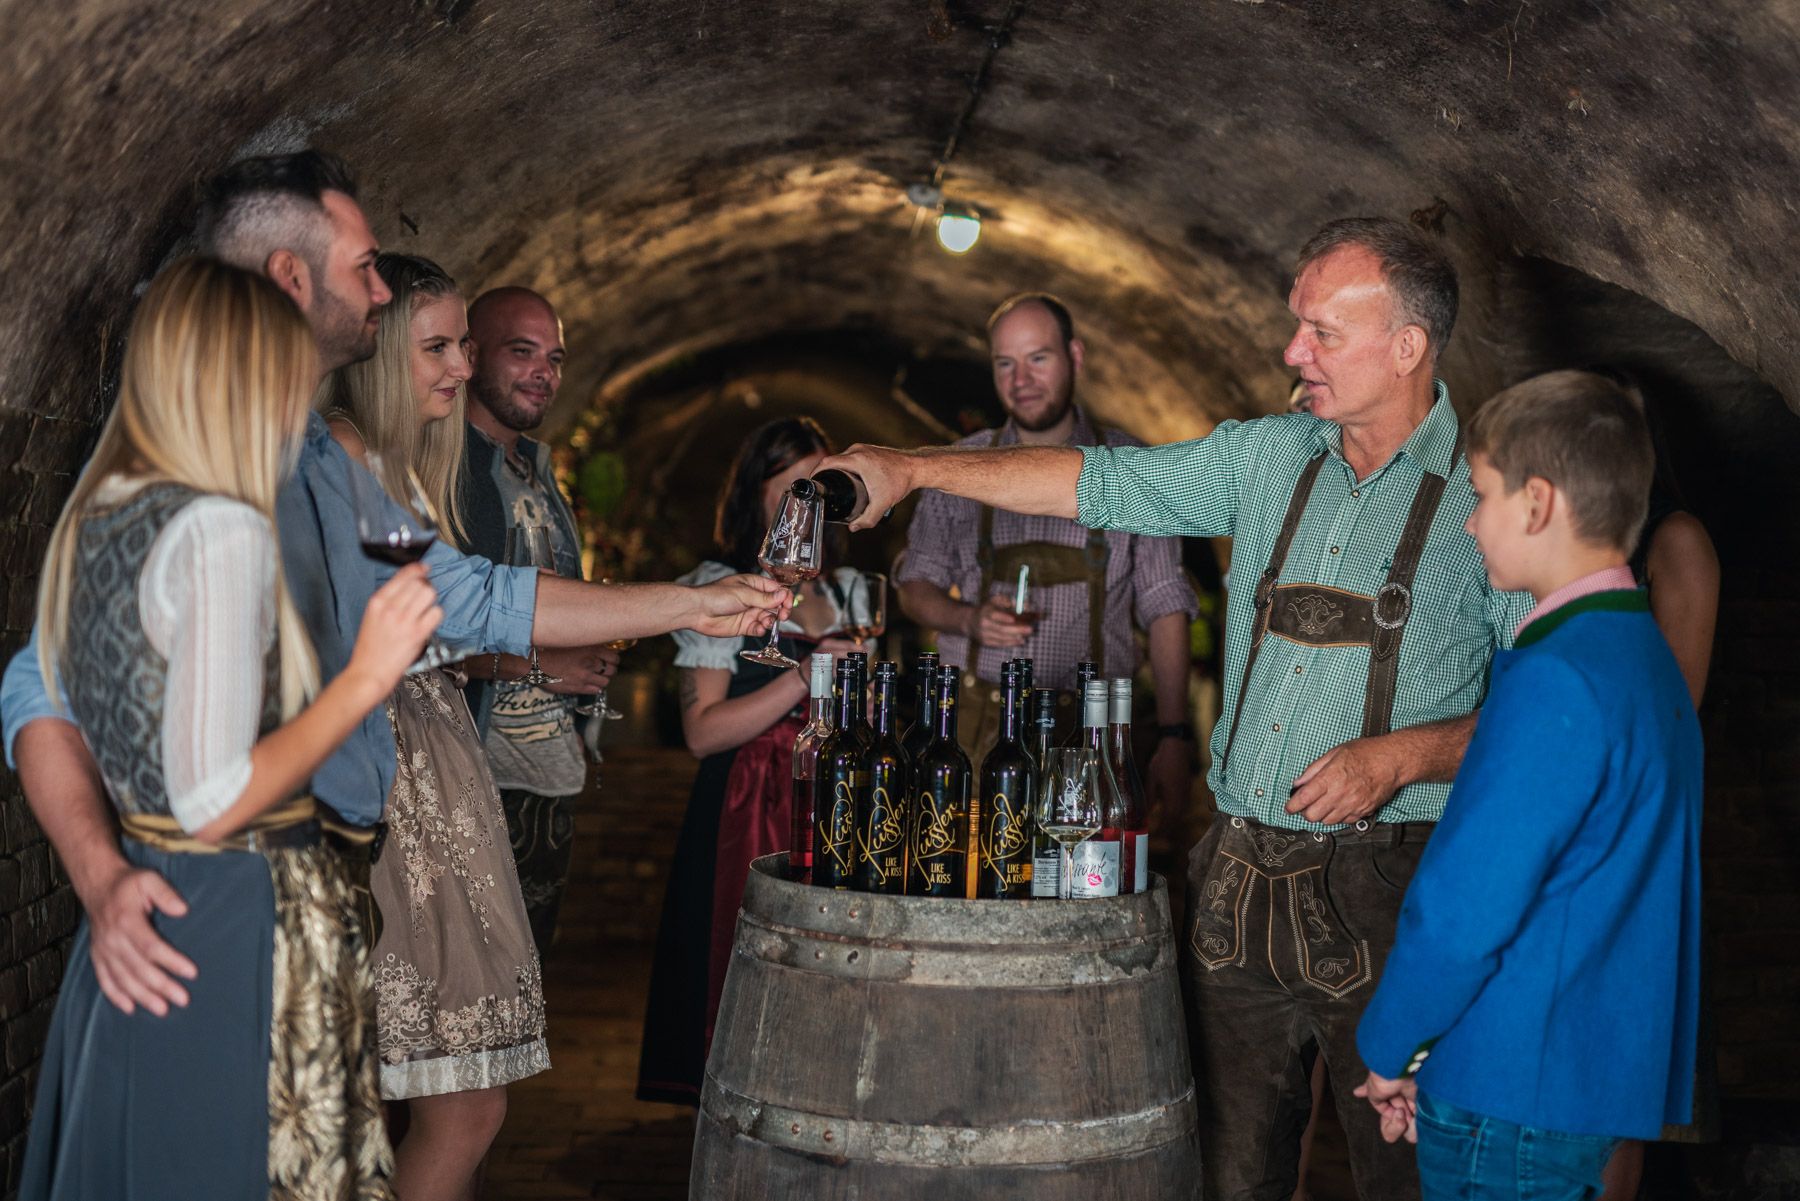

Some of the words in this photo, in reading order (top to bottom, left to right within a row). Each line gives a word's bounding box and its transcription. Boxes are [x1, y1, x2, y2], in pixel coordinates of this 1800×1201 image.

[885, 857, 898, 867] LIKE
[884, 867, 890, 877] A
[890, 867, 902, 877] KISS
[930, 862, 944, 873] LIKE
[1006, 863, 1020, 873] LIKE
[930, 873, 936, 884] A
[937, 873, 951, 884] KISS
[1006, 874, 1012, 884] A
[1012, 874, 1025, 884] KISS
